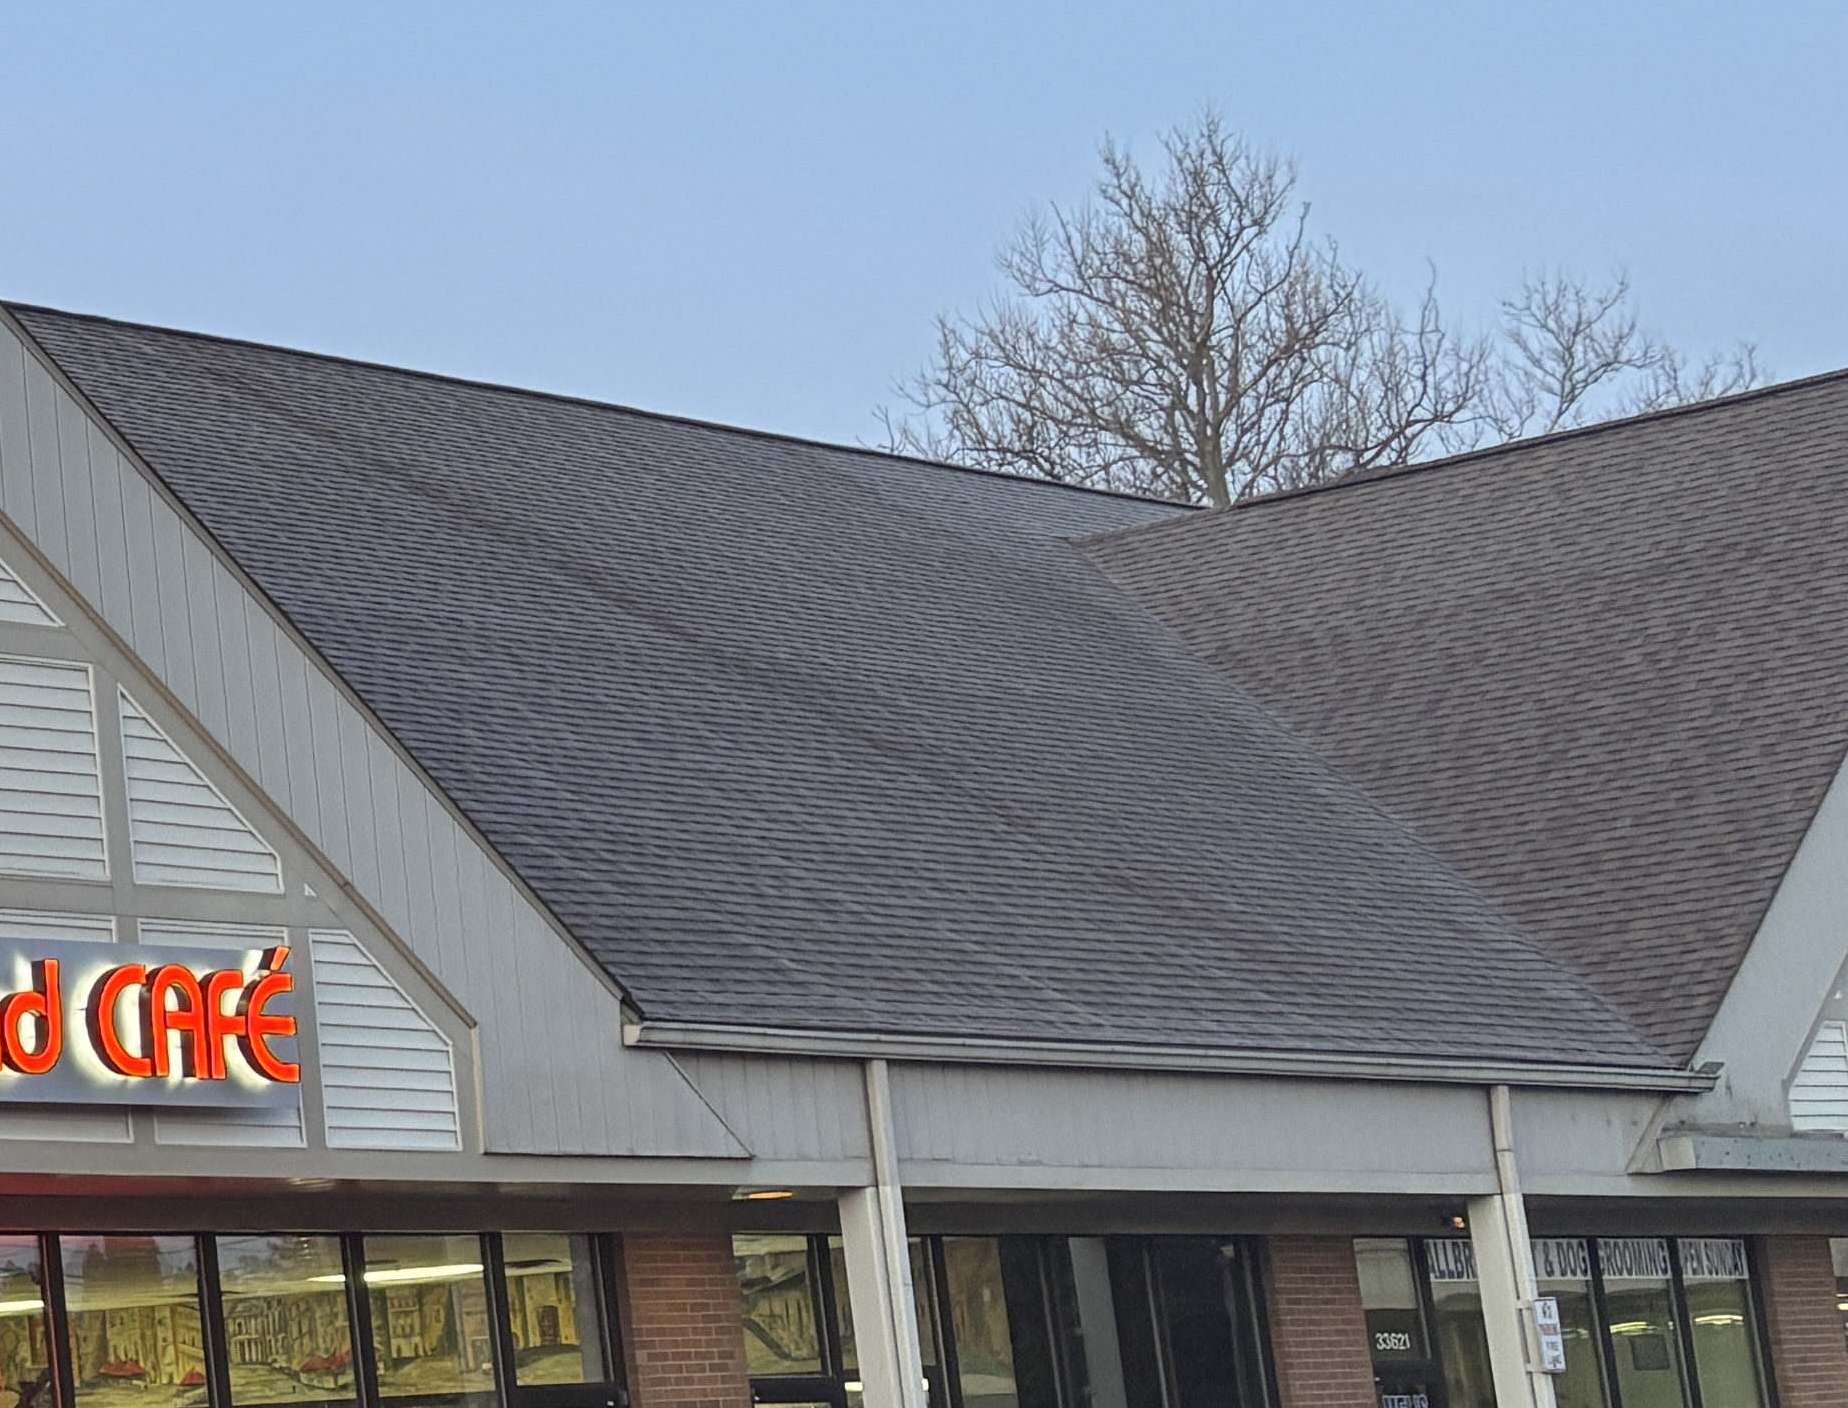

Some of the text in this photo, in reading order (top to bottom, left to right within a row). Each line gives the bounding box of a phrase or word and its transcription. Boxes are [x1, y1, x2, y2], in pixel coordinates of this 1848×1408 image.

[90, 945, 300, 1084] CAFÉ
[1427, 1241, 1478, 1280] ALLBR
[1543, 1241, 1555, 1278] &
[1556, 1240, 1589, 1277] DOG
[1598, 1240, 1670, 1277] GROOMING
[1679, 1240, 1704, 1277] PEN
[1375, 1333, 1410, 1350] 33621
